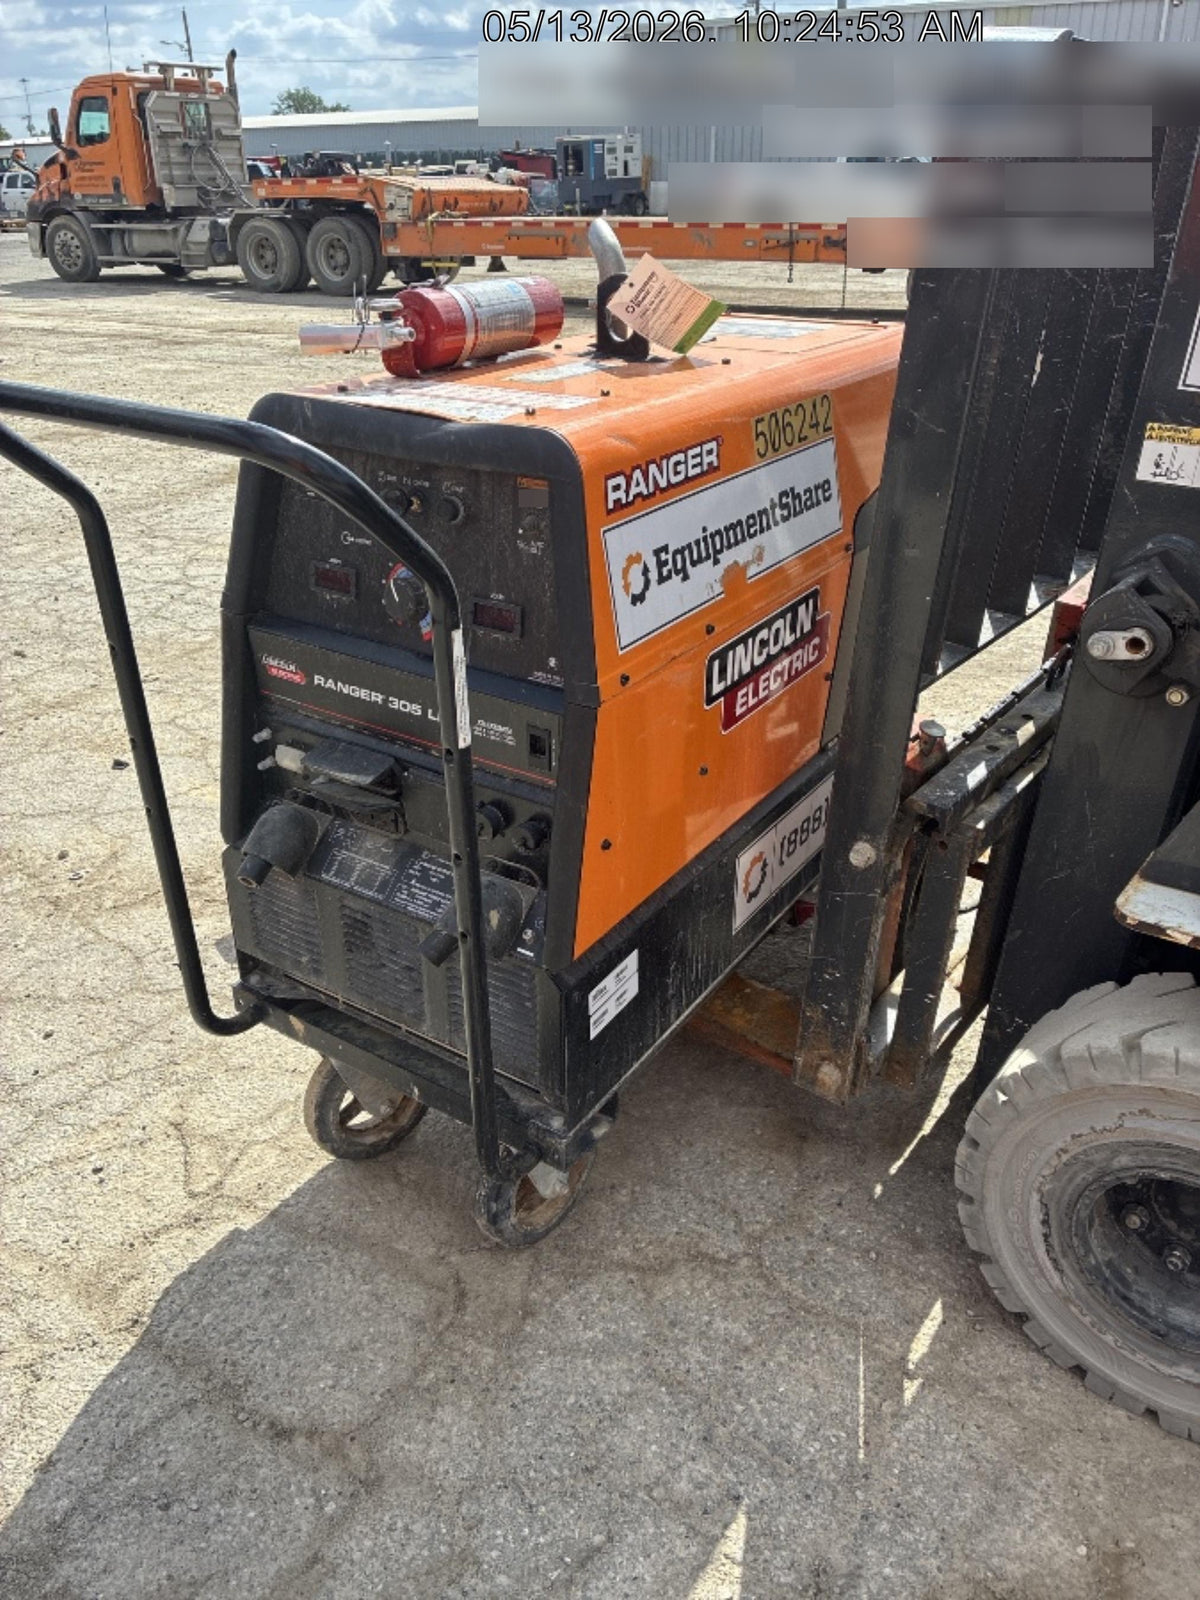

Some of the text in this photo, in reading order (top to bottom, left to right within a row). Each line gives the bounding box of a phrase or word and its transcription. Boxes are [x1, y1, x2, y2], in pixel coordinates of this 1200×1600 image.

[754, 394, 833, 459] 506242
[606, 439, 720, 510] RANGER
[652, 478, 833, 586] EquipmentShare
[712, 598, 814, 696] LINCOLN
[735, 637, 821, 717] ELECTRIC
[313, 674, 383, 705] RANGER
[388, 696, 423, 716] 305
